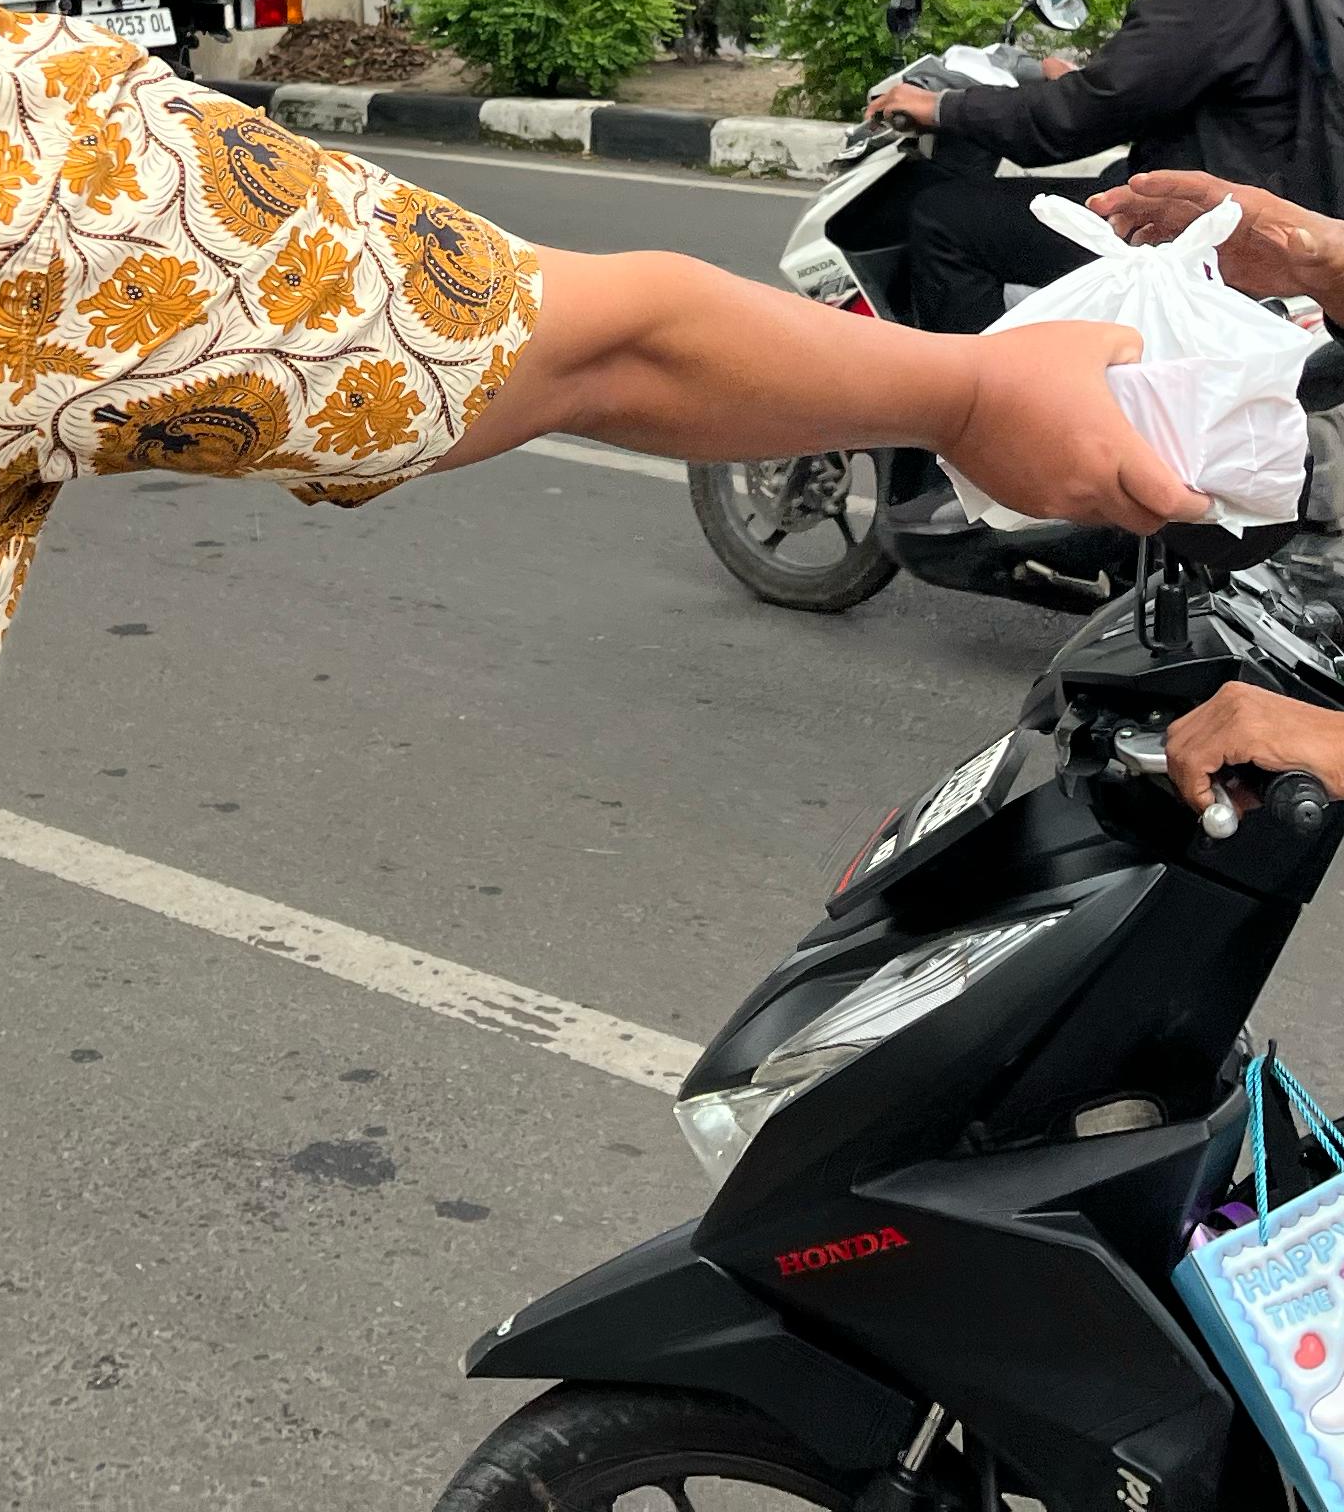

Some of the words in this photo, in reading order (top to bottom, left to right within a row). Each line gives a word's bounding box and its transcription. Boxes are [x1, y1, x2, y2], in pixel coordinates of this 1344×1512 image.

[151, 13, 170, 32] OL
[797, 259, 837, 278] HONDA
[776, 1226, 910, 1276] HONDA
[1263, 1286, 1335, 1329] TIME
